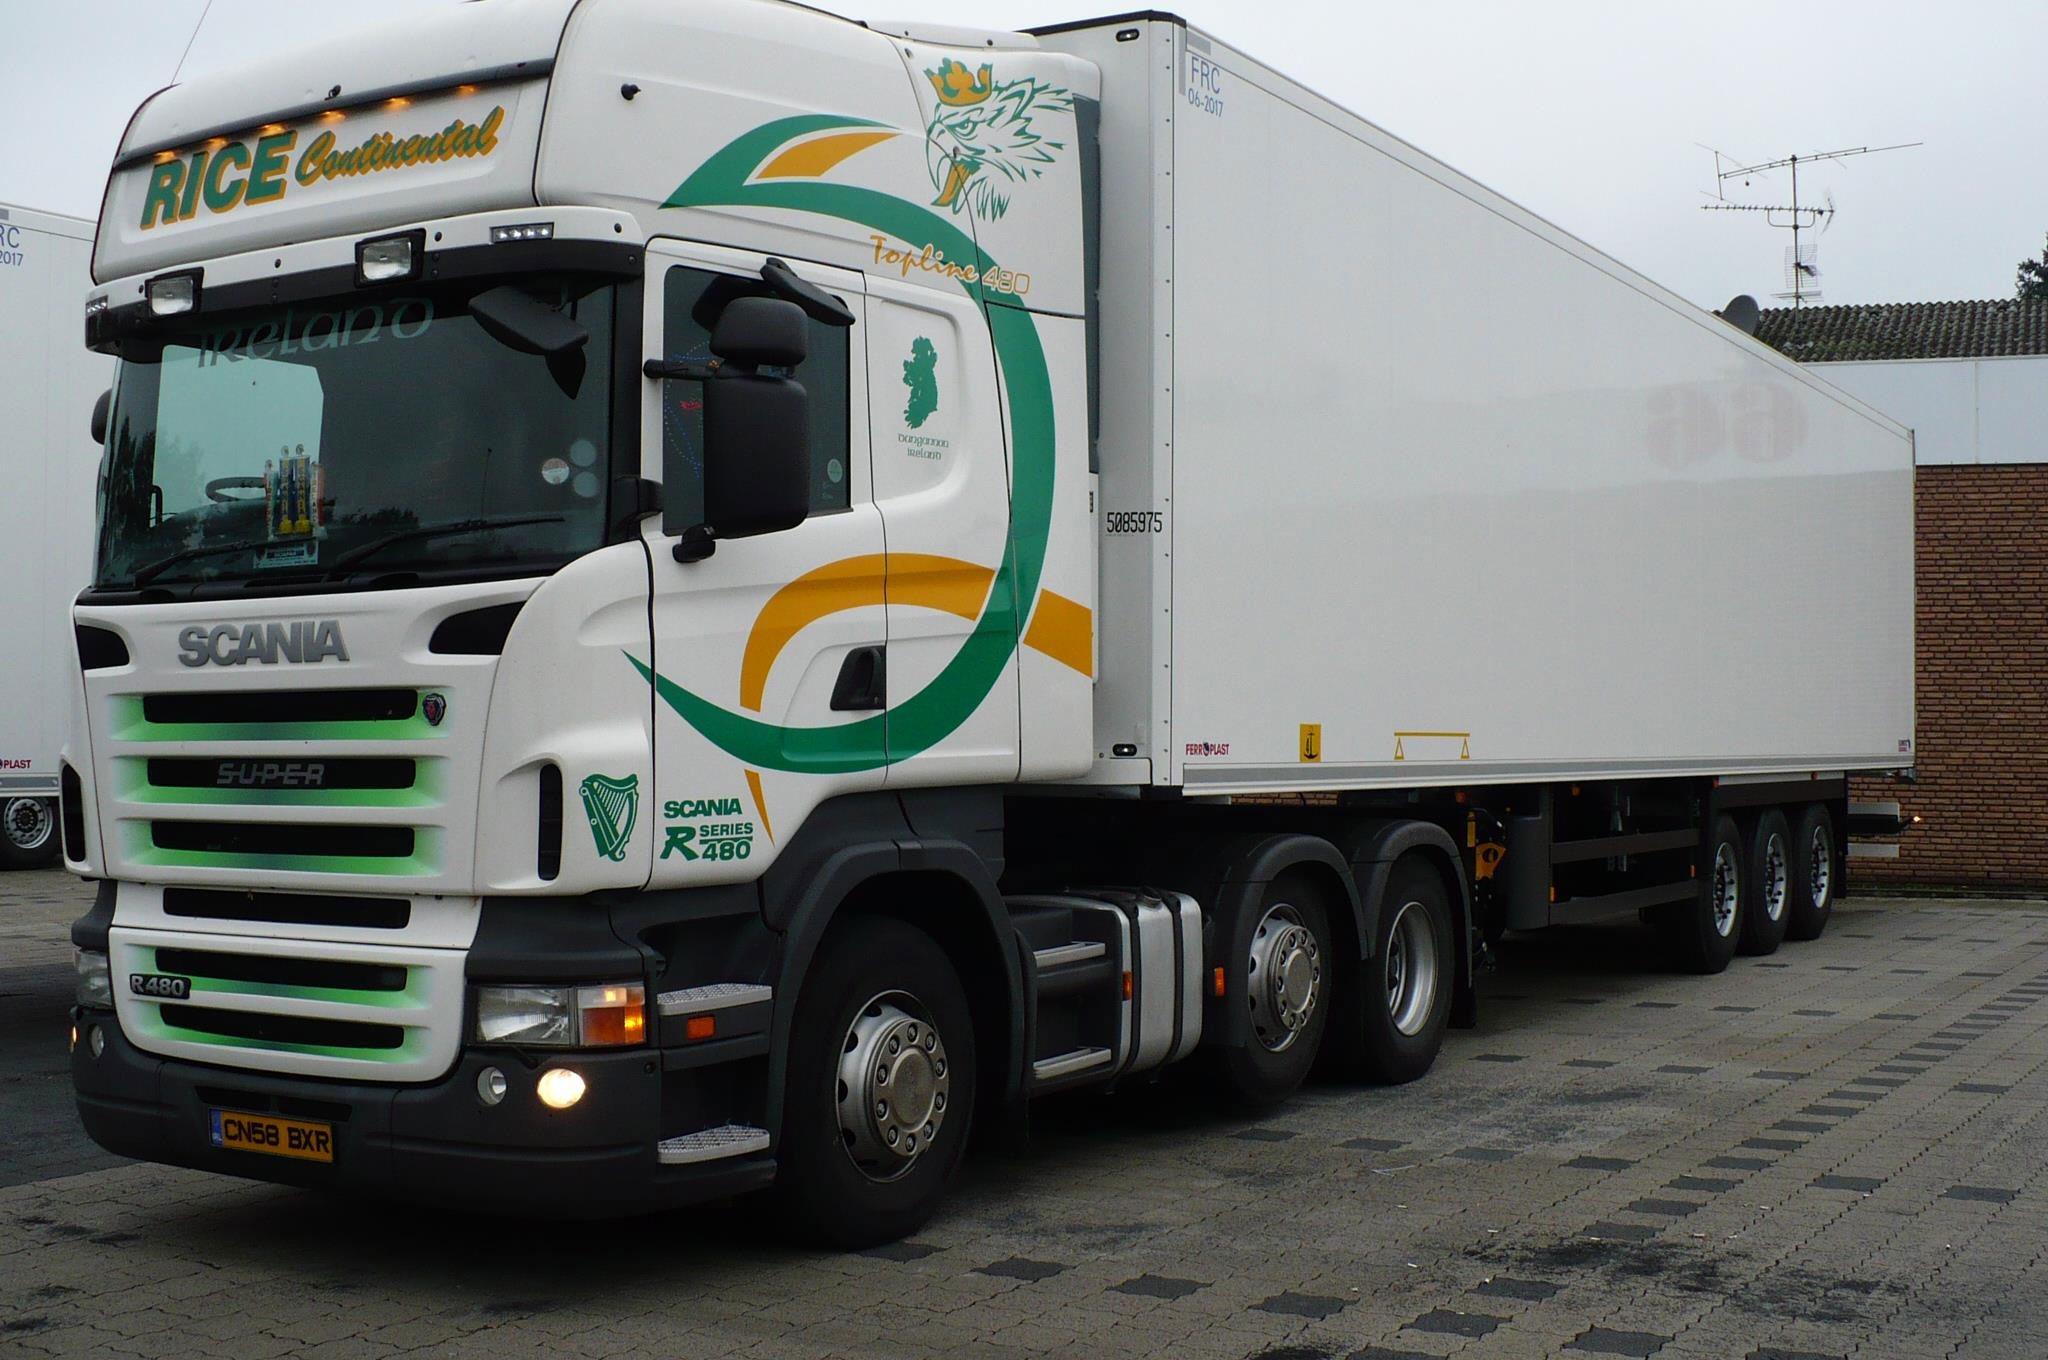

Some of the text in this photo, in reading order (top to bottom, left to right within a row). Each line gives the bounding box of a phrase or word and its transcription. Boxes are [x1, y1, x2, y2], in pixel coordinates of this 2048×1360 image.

[1191, 56, 1220, 94] FRC
[1188, 88, 1224, 117] 06-2017
[140, 105, 505, 230] RICE Continental
[869, 233, 1032, 295] Topline 480
[1106, 511, 1163, 533] 5085975
[178, 620, 350, 668] SCANIA
[217, 762, 325, 786] SUPER
[663, 798, 743, 819] SCANIA
[660, 822, 754, 861] R SERIES
[702, 840, 751, 862] 480
[224, 1118, 280, 1147] CN58
[287, 1126, 331, 1154] BXR
